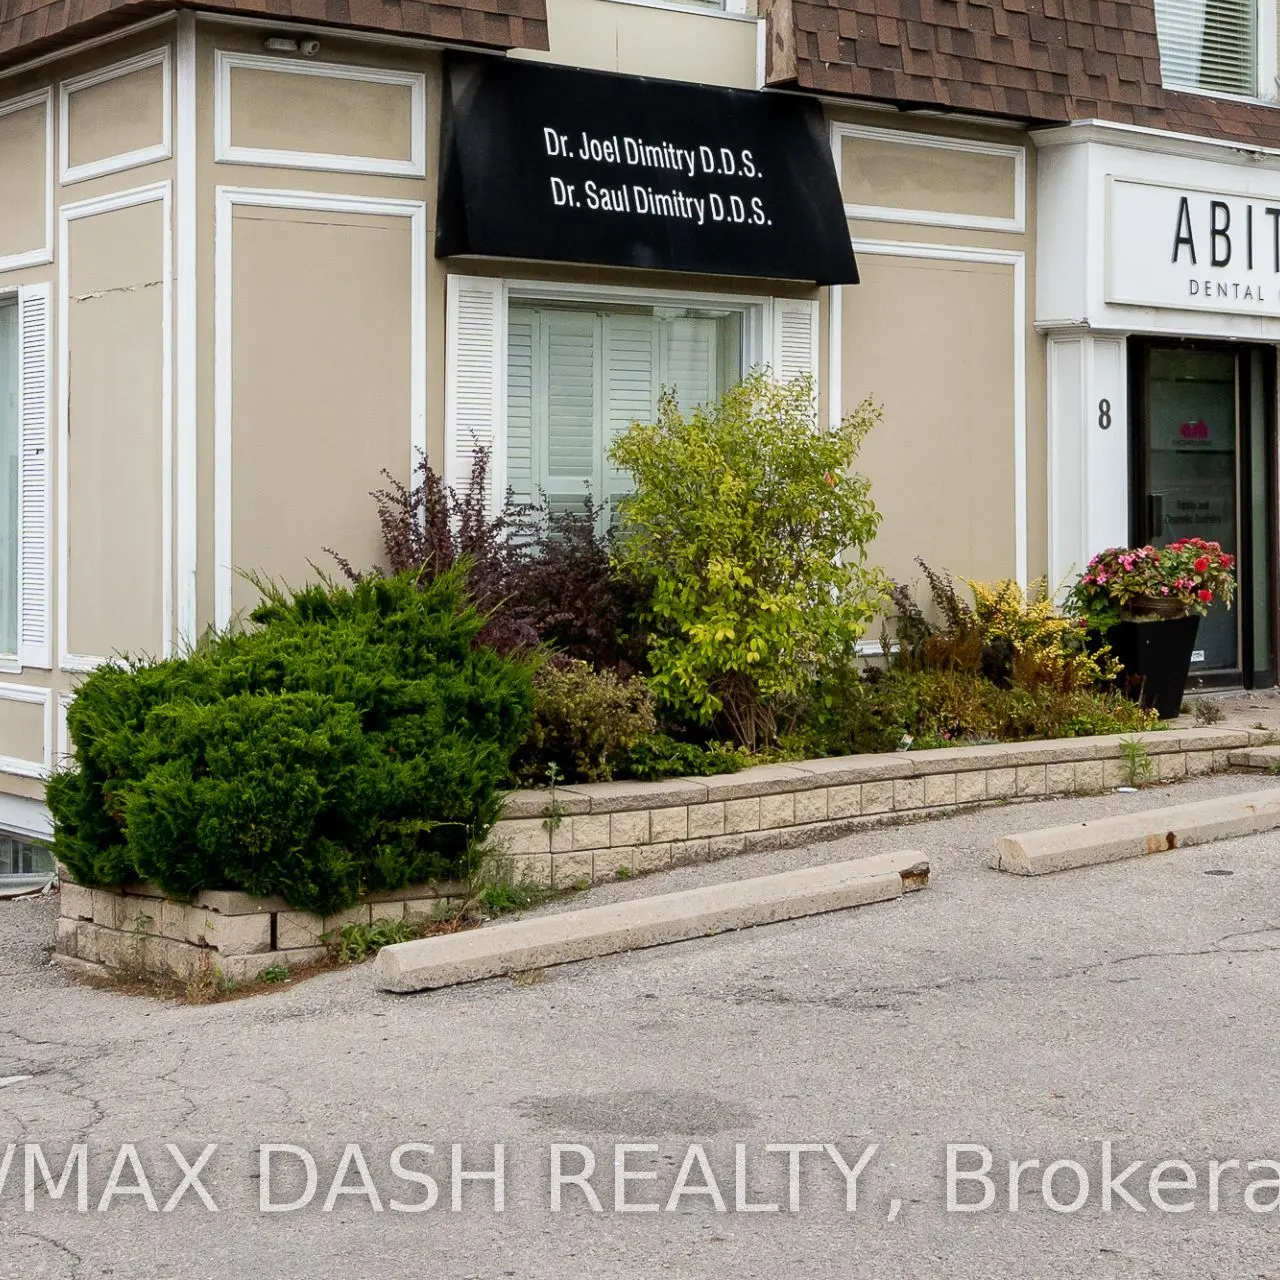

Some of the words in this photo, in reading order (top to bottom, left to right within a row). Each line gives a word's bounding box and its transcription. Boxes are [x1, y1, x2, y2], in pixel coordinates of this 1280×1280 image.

[543, 126, 574, 159] Dr.
[578, 131, 622, 164] Joel
[623, 136, 696, 177] Dimitry
[699, 145, 763, 178] D.D.S.
[550, 176, 581, 208] Dr.
[586, 180, 631, 213] Saul
[632, 185, 706, 225] Dimitry
[709, 193, 773, 226] D.D.S.
[1189, 279, 1265, 301] DENTAL
[1098, 398, 1112, 430] 8
